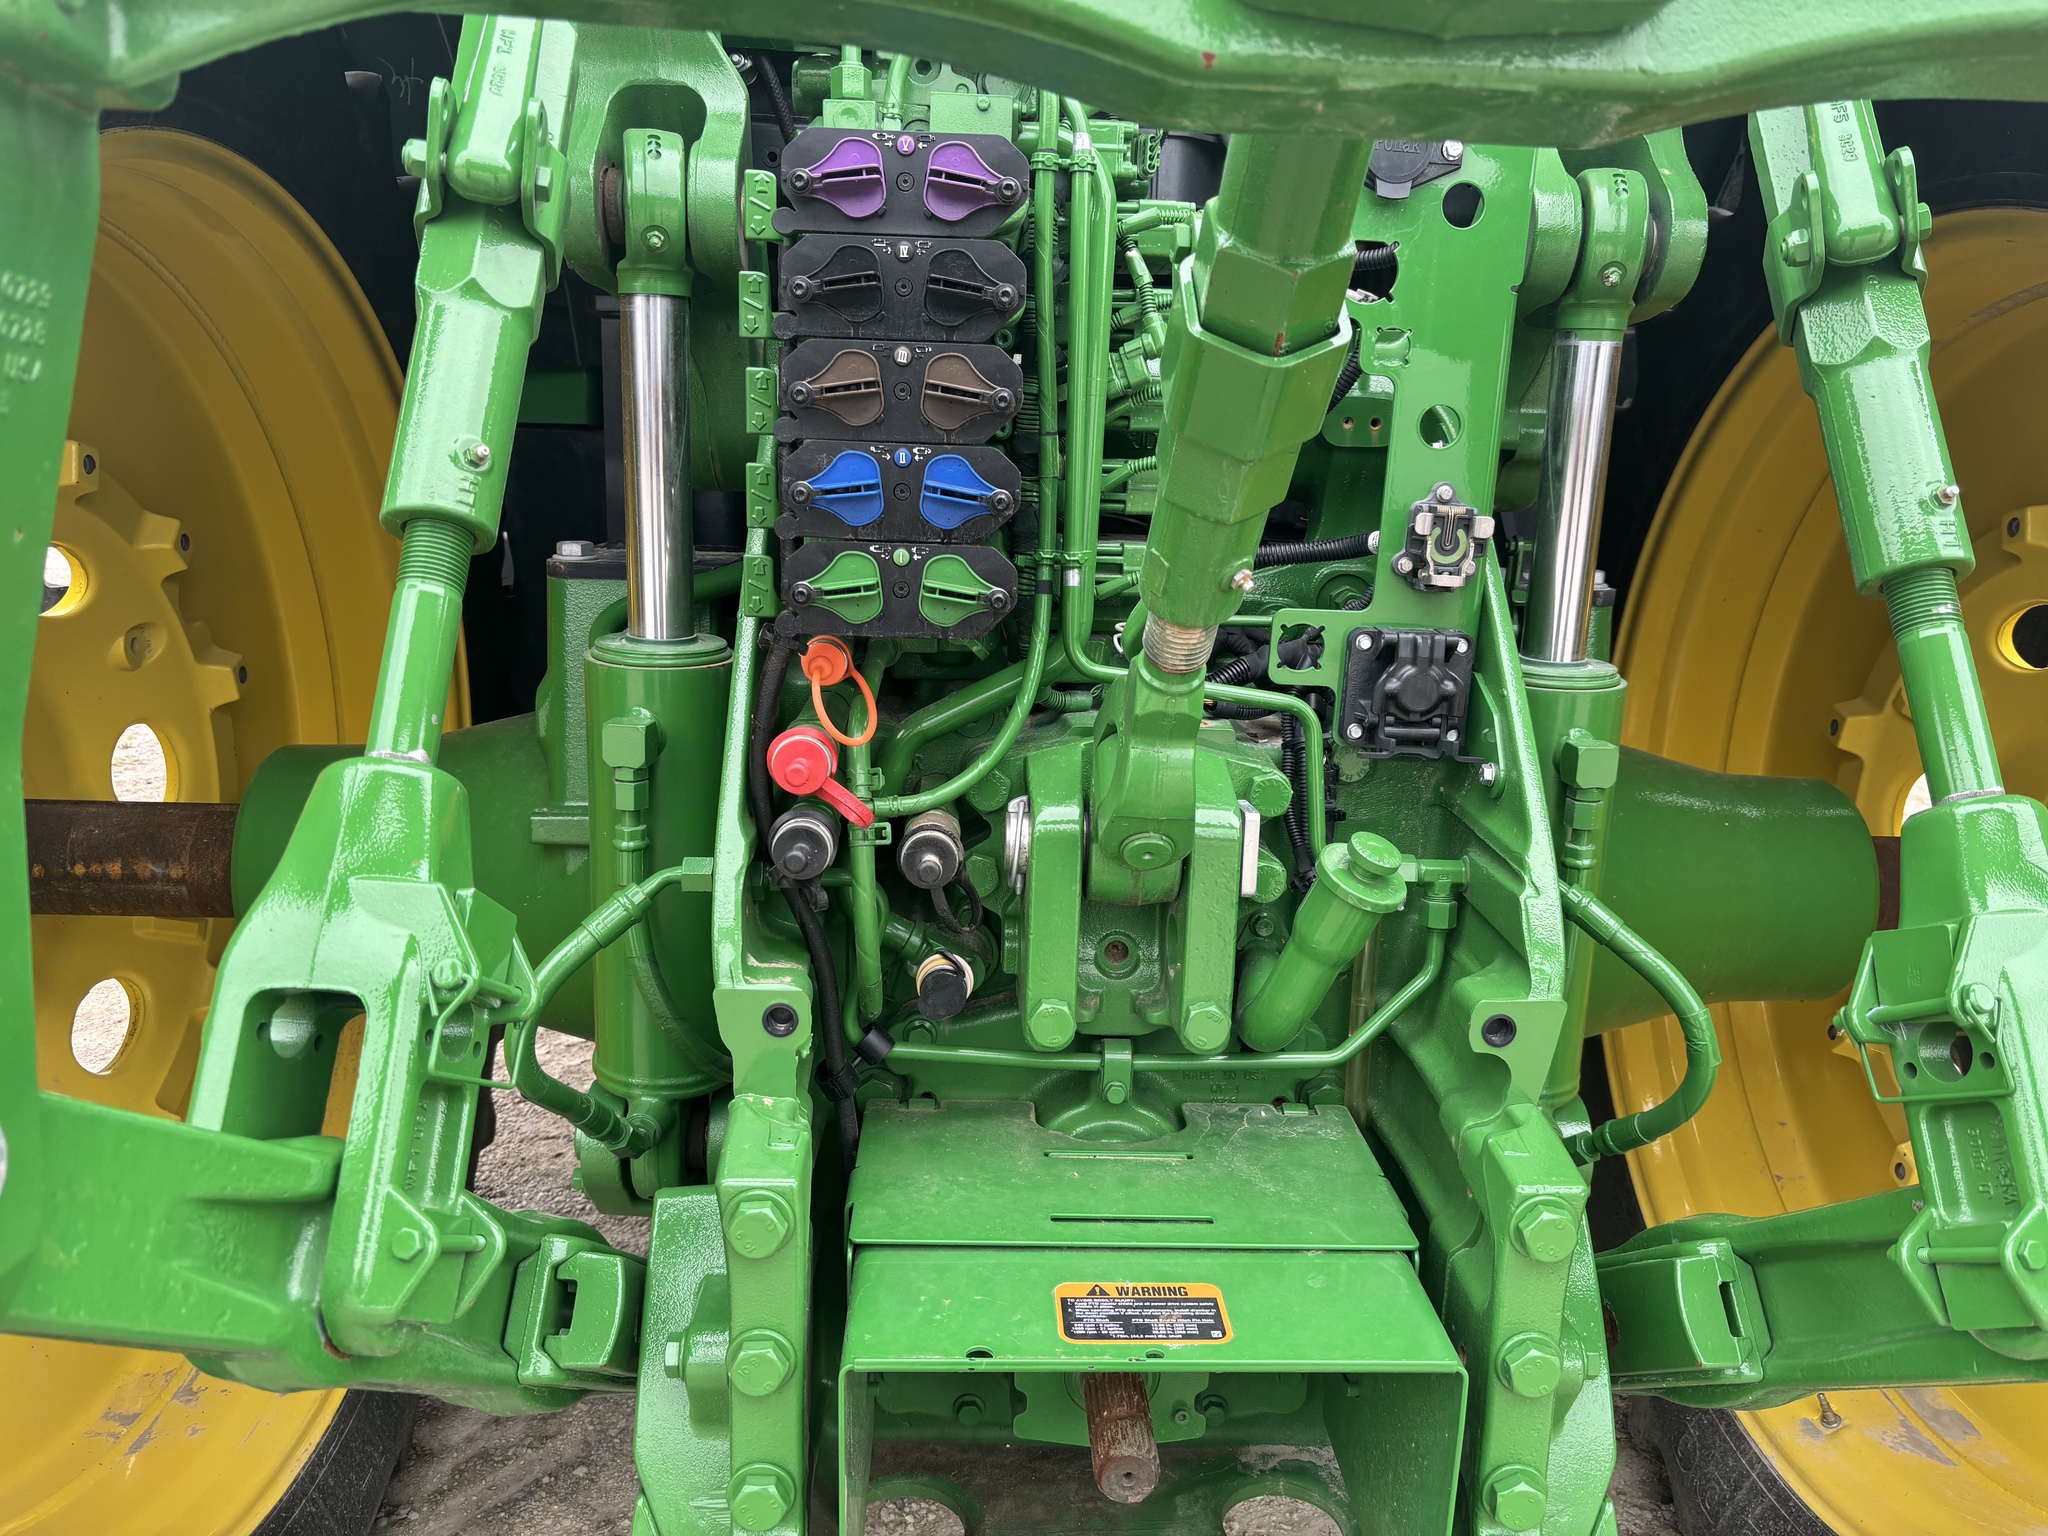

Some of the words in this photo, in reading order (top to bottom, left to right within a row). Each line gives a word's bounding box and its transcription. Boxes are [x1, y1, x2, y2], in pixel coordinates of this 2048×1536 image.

[901, 138, 911, 152] V
[899, 245, 910, 258] IV
[897, 350, 908, 363] III
[899, 452, 906, 464] II
[1182, 1069, 1215, 1081] MADE
[1244, 1069, 1268, 1081] USA
[1115, 1286, 1189, 1297] WARNING
